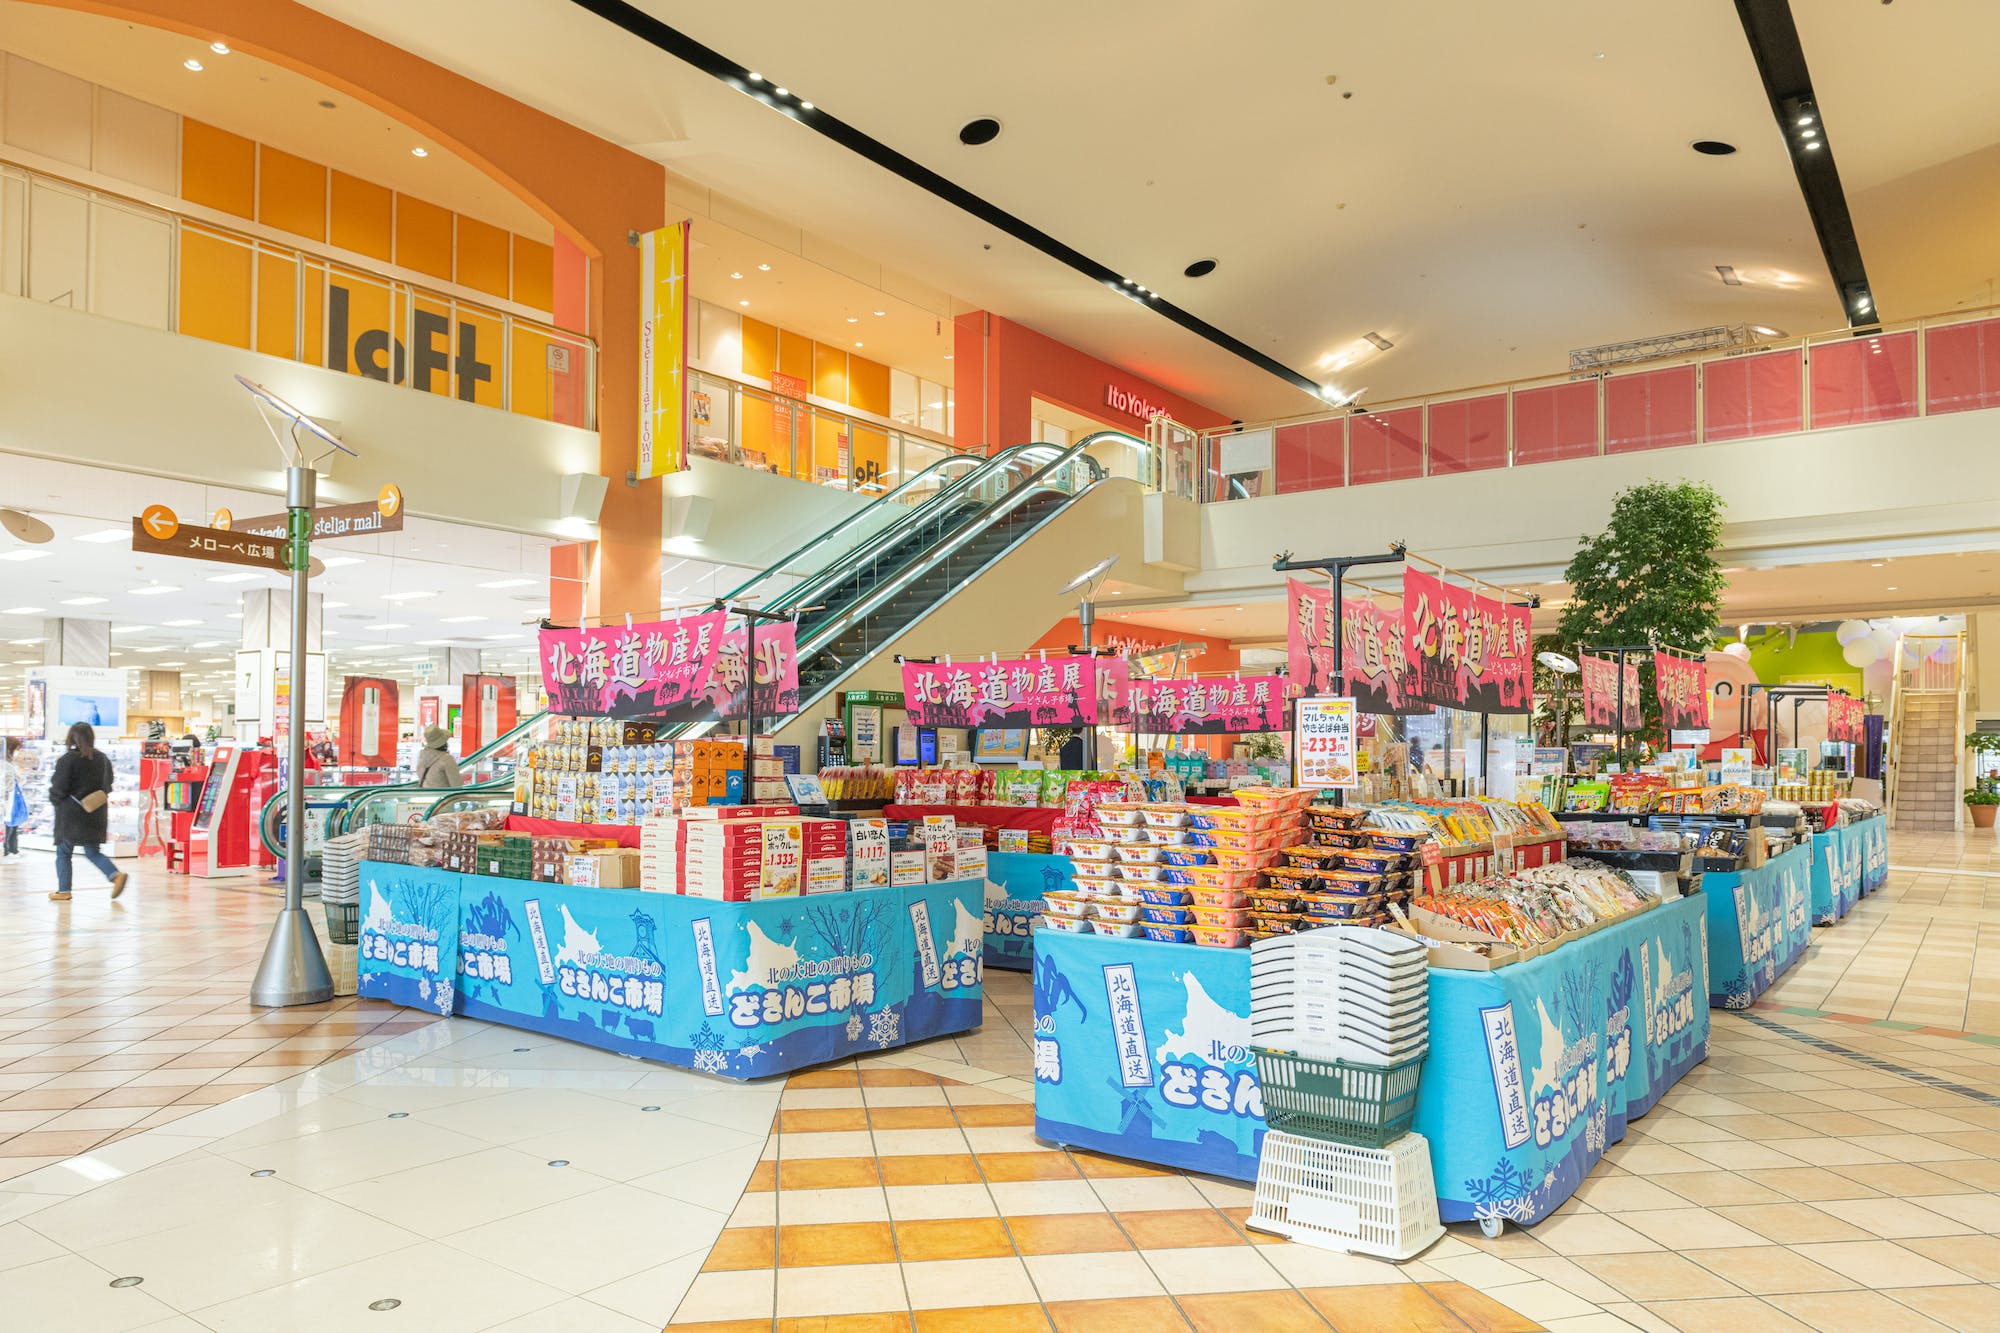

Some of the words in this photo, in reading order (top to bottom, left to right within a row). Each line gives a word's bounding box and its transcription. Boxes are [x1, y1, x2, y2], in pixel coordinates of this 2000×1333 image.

[643, 320, 652, 412] Stellar
[642, 422, 651, 463] town
[314, 516, 352, 536] stellar
[353, 510, 382, 531] mall
[189, 535, 275, 560] メローペ広場
[244, 672, 252, 688] 7
[913, 662, 1085, 711] 北海道物産展
[1127, 680, 1271, 719] 北海道物産展
[1302, 723, 1350, 734] やきそば弁当
[1303, 713, 1344, 722] マルちゃん
[856, 829, 886, 841] 白い恋人
[927, 823, 947, 832] マルセイ
[767, 952, 873, 984] 北の大地の贈りもの
[558, 965, 665, 1017] どさんこ市場
[729, 970, 876, 1028] どさんこ市場
[1112, 973, 1152, 1081] 北海道直送
[1494, 1016, 1528, 1138] 北海道直送
